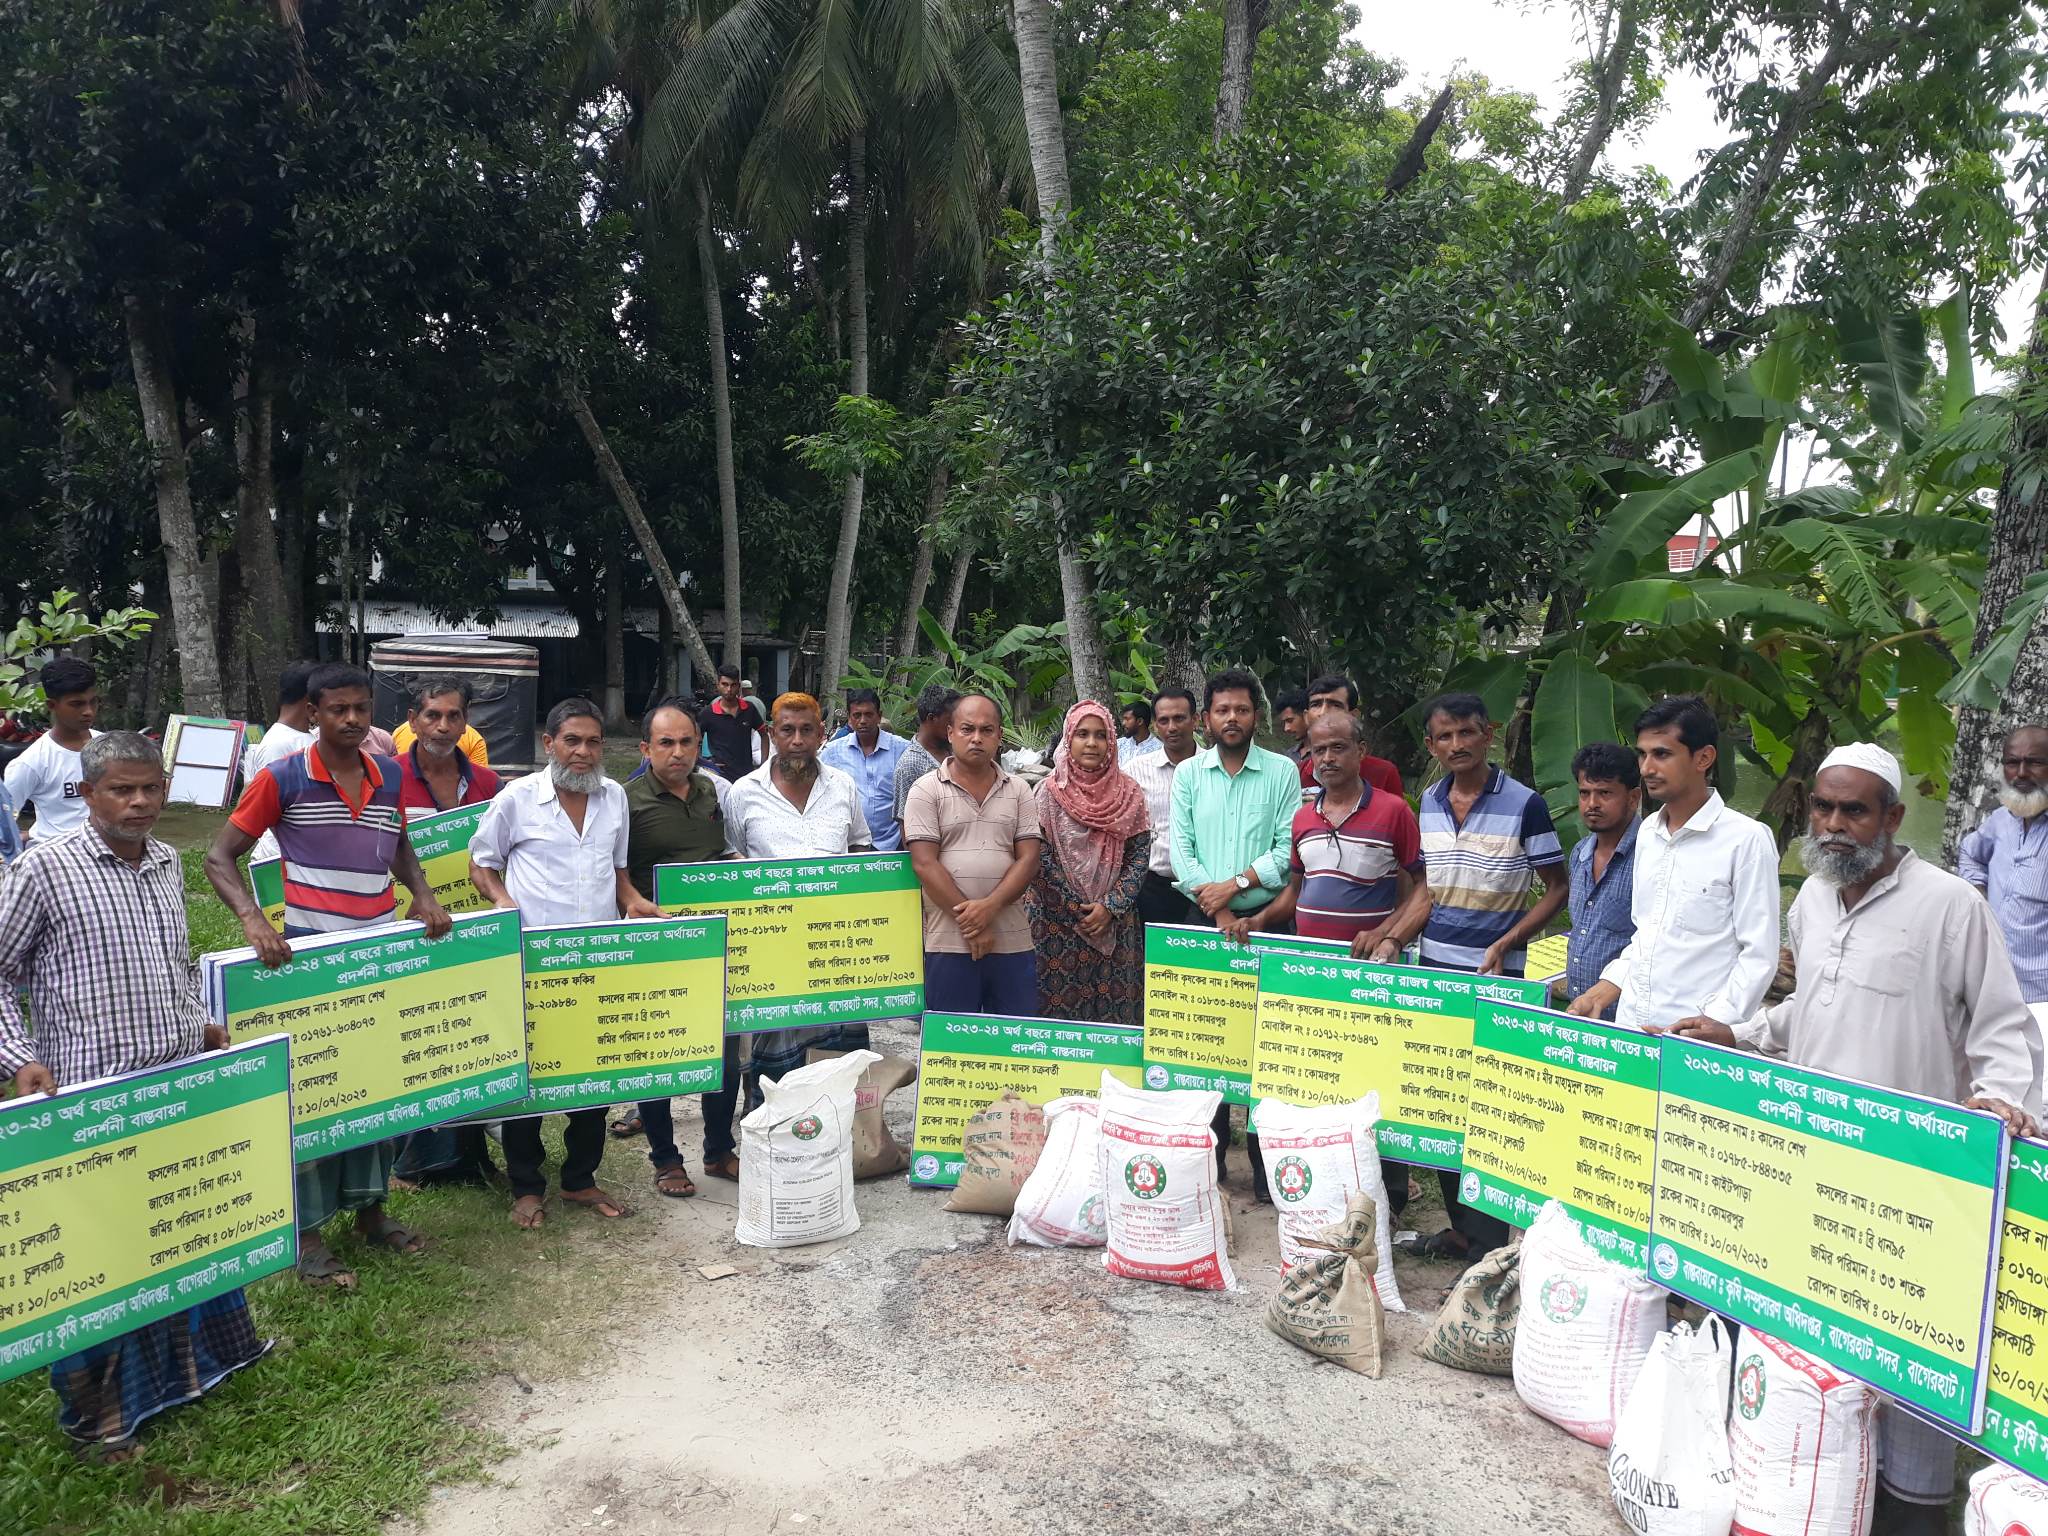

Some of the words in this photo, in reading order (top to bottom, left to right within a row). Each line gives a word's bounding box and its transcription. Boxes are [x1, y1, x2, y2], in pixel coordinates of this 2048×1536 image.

[681, 870, 738, 883] ২০২৩-২৪
[742, 865, 761, 878] অর্থ
[764, 867, 792, 879] বছরে
[796, 865, 824, 876] রাজস্ব
[828, 863, 860, 874] খাতের
[863, 859, 902, 871] অর্থায়নে
[753, 881, 791, 895] প্রদর্শনী
[794, 881, 837, 892] বাস্তবায়ন
[731, 907, 745, 916] নাম
[754, 904, 775, 915] সাইদ
[777, 903, 793, 913] শেখ
[529, 935, 551, 949] অর্থ
[554, 936, 585, 948] বছরে
[589, 934, 620, 945] রাজস্ব
[624, 931, 659, 942] খাতের
[663, 926, 706, 939] অর্থায়নে
[807, 940, 827, 950] জাতের
[828, 939, 840, 948] নাম
[336, 962, 379, 983] প্রদর্শনী
[382, 955, 429, 974] বাস্তবায়ন
[540, 950, 582, 966] প্রদর্শনী
[585, 950, 634, 962] বাস্তবায়ন
[541, 977, 569, 988] সাদেক
[571, 972, 595, 985] ফকির
[807, 977, 830, 988] রোপন
[833, 974, 855, 985] তারিখ
[863, 971, 914, 984] ১০/০৮/২০২৩
[1150, 968, 1179, 982] প্রদর্শনীর
[1180, 973, 1207, 986] কৃষকের
[1208, 977, 1222, 987] নাম
[234, 1011, 273, 1032] প্রদর্শনীর
[276, 1006, 310, 1026] কৃষকের
[312, 1001, 329, 1014] নাম
[339, 994, 365, 1008] সালাম
[368, 989, 385, 1003] শেখ
[597, 1014, 619, 1024] জাতের
[620, 1012, 633, 1022] নাম
[640, 1008, 648, 1021] ব্রি
[739, 1004, 754, 1025] কৃষি
[827, 995, 861, 1012] বাগেরহাট
[883, 990, 916, 1007] বাগেরহাট
[1192, 1013, 1226, 1027] কোমরপুর
[1262, 998, 1294, 1012] প্রদর্শনীর
[1296, 1003, 1324, 1017] কৃষকের
[1326, 1008, 1341, 1018] নাম
[1394, 1013, 1413, 1029] সিংহ
[300, 1016, 375, 1041] ০১৭৬১-৬০৪০৭৩
[401, 1050, 420, 1064] জমির
[422, 1044, 448, 1058] পরিমান
[456, 1040, 468, 1050] ৩৩
[470, 1033, 489, 1046] শতক
[596, 1054, 621, 1065] রোপন
[623, 1049, 648, 1061] তারিখ
[656, 1044, 714, 1059] ০৮/০৮/২০২৩
[926, 1055, 957, 1068] প্রদর্শনীর
[959, 1060, 986, 1072] কৃষকের
[989, 1062, 1002, 1071] নাম
[1010, 1063, 1030, 1073] মানস
[1011, 1042, 1048, 1055] প্রদর্শনী
[1051, 1046, 1094, 1058] বাস্তবায়ন
[57, 1098, 85, 1120] অর্থ
[89, 1092, 128, 1113] বছরে
[132, 1081, 169, 1102] রাজস্ব
[174, 1069, 214, 1090] খাতের
[218, 1055, 266, 1077] অর্থায়নে
[297, 1071, 337, 1091] কোমরপুর
[1474, 1054, 1499, 1070] প্রদর্শনীর
[1501, 1061, 1523, 1076] কৃষকের
[1524, 1067, 1535, 1080] নাম
[1542, 1067, 1553, 1084] মীর
[1584, 1083, 1604, 1098] হাসান
[305, 1088, 367, 1113] ১০/০৭/২০২৩
[1684, 1054, 1744, 1081] ২০২৩-২৪
[1747, 1069, 1771, 1088] অর্থ
[1773, 1076, 1808, 1098] বছরে
[1811, 1086, 1849, 1109] রাজস্ব
[1854, 1097, 1901, 1124] খাতের
[1904, 1110, 1968, 1142] অর্থায়নে
[73, 1113, 125, 1142] প্রদর্শনী
[129, 1100, 186, 1126] বাস্তবায়ন
[1664, 1103, 1697, 1123] প্রদর্শনীর
[1699, 1112, 1730, 1133] কৃষকের
[1732, 1123, 1748, 1139] নাম
[1757, 1130, 1785, 1151] কাদের
[1787, 1141, 1806, 1158] শেখ
[1758, 1099, 1803, 1124] প্রদর্শনী
[1806, 1111, 1865, 1142] বাস্তবায়ন
[41, 1166, 63, 1183] নাম
[75, 1151, 114, 1174] গোবিন্দ
[117, 1145, 137, 1161] পাল
[147, 1162, 179, 1181] ফসলের
[181, 1156, 197, 1171] নাম
[206, 1146, 227, 1164] রোপা
[228, 1139, 251, 1155] আমন
[1660, 1158, 1685, 1176] গ্রামের
[1687, 1166, 1702, 1183] নাম
[1663, 1131, 1695, 1151] মোবাইল
[1697, 1141, 1707, 1157] নং
[1717, 1150, 1792, 1185] ০১৭৮৫-৮৪৪৩৩৫
[147, 1191, 175, 1210] জাতের
[176, 1186, 190, 1200] নাম
[198, 1177, 214, 1194] বিনা
[1131, 1187, 1158, 1199] TCB
[1660, 1185, 1682, 1204] ব্লকের
[1684, 1194, 1699, 1211] নাম
[1707, 1204, 1744, 1231] কোমরপুর
[1815, 1182, 1848, 1205] ফসলের
[1850, 1193, 1868, 1212] নাম
[1877, 1204, 1903, 1224] রোপা
[1905, 1212, 1933, 1235] আমন
[18, 1222, 61, 1256] চুলকাঠি
[1658, 1213, 1676, 1231] বপন
[1678, 1220, 1702, 1241] তারিখ
[1710, 1234, 1768, 1270] ১০/০৭/২০২৩
[1812, 1213, 1839, 1235] জাতের
[1841, 1223, 1856, 1241] নাম
[1865, 1227, 1874, 1250] ব্রি
[23, 1251, 65, 1285] চুলকাঠি
[1810, 1243, 1833, 1265] জমির
[1836, 1252, 1868, 1279] পরিমান
[1879, 1273, 1895, 1289] ৩৩
[1899, 1278, 1926, 1300] শতক
[28, 1272, 105, 1311] ১০/০৭/২০২৩
[1807, 1275, 1837, 1300] রোপন
[1839, 1288, 1870, 1314] তারিখ
[1881, 1310, 1965, 1352] ০৮/০৮/২০২৩
